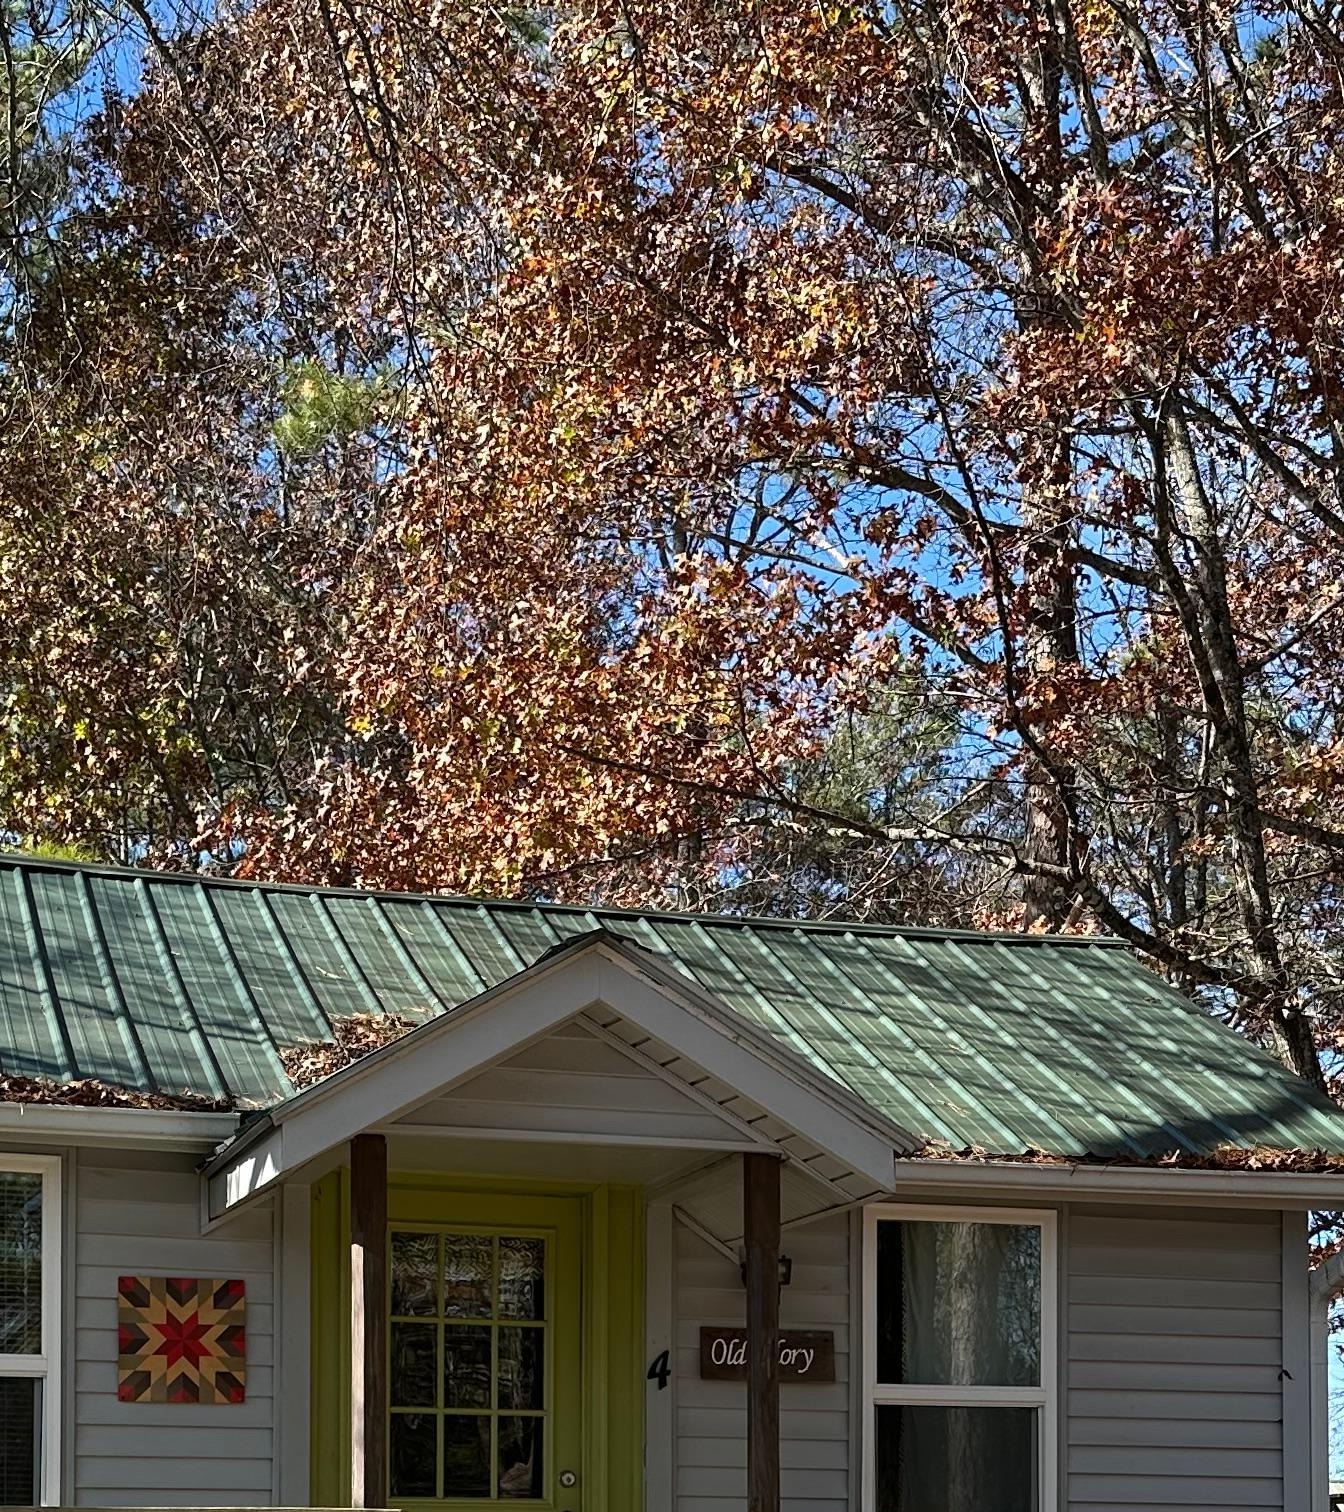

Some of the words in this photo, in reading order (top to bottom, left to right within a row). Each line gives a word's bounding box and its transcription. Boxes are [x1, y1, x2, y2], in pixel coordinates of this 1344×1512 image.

[647, 1350, 672, 1391] 4
[711, 1338, 748, 1365] Old
[777, 1339, 814, 1374] ory
